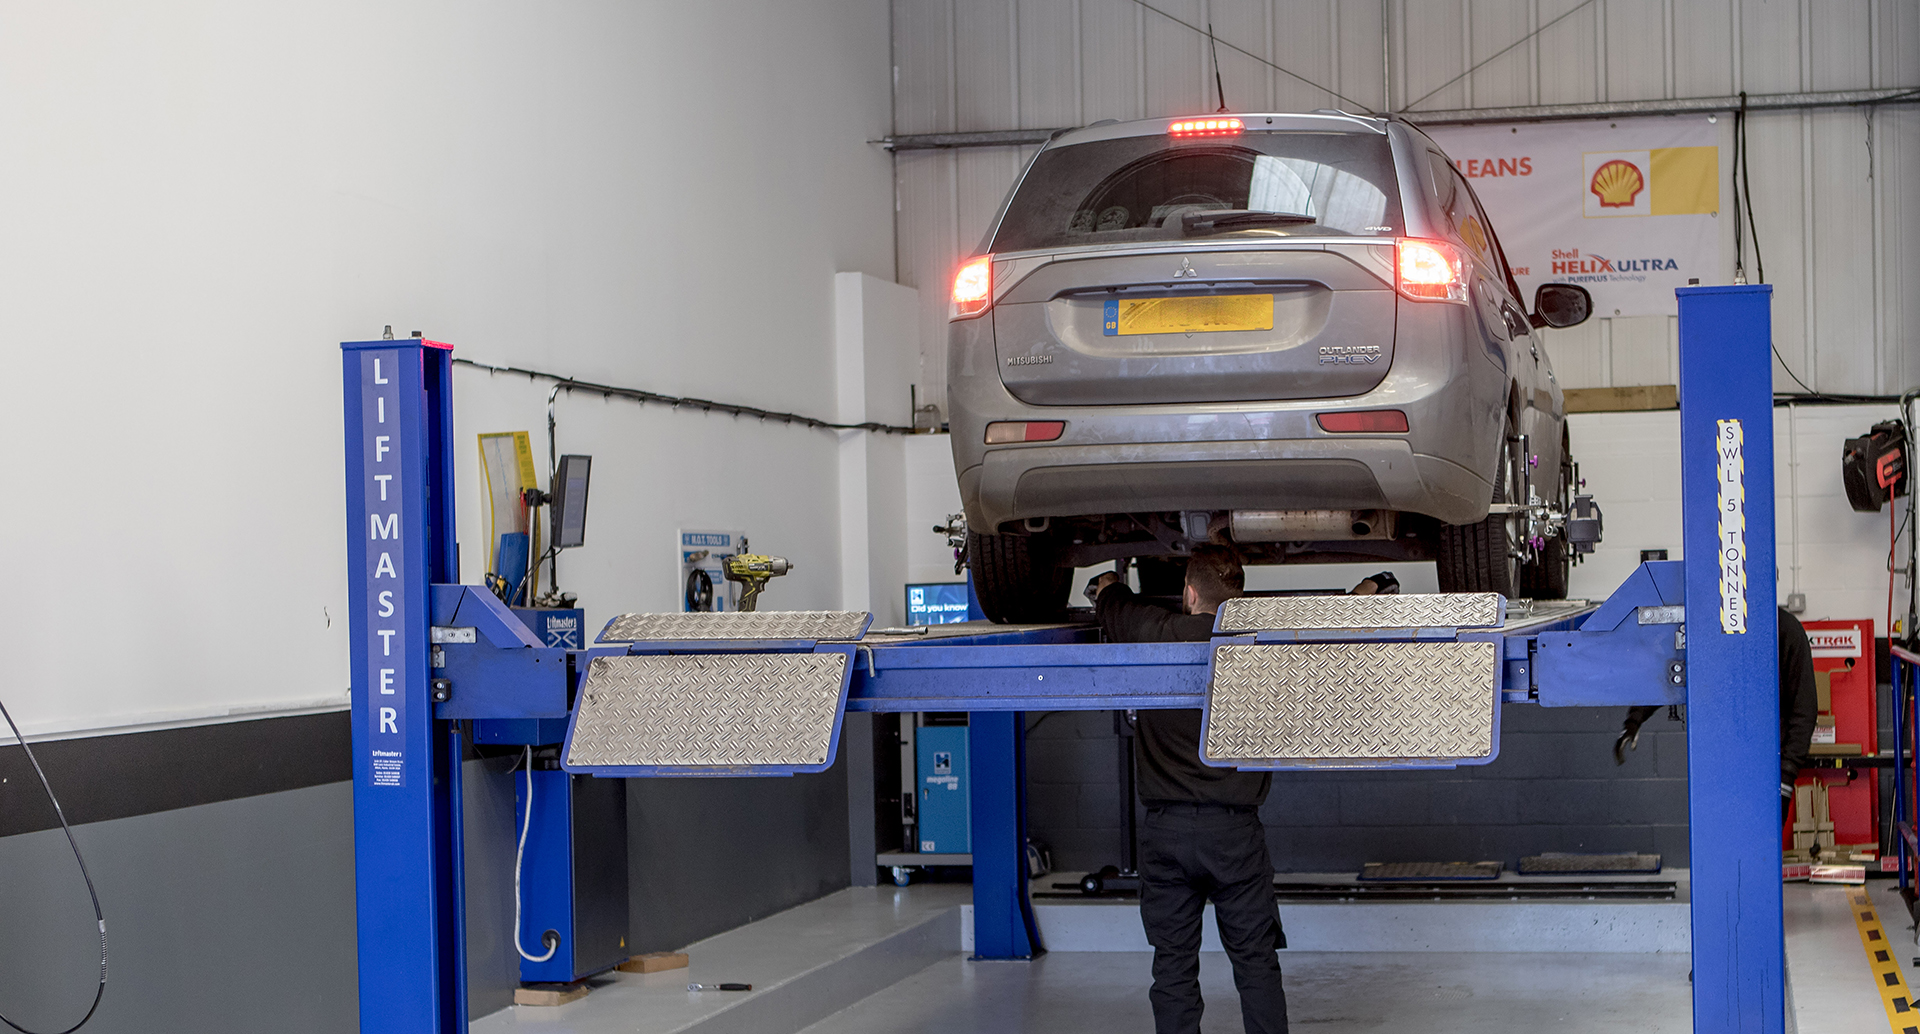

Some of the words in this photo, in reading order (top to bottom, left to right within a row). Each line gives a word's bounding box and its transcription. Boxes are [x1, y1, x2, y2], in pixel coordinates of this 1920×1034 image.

[1551, 248, 1579, 260] Shell
[1551, 259, 1615, 275] HELIX
[1617, 258, 1679, 272] ULTRA
[1568, 275, 1608, 283] PUREPLUS
[1609, 274, 1646, 282] Technology
[1105, 321, 1117, 330] GB
[1319, 345, 1380, 355] OUTLANDER
[1007, 355, 1053, 366] MITSUBISHI
[1319, 354, 1382, 365] PHEV
[1727, 498, 1736, 512] 5
[706, 535, 723, 545] TOOLS
[371, 358, 399, 735] LIFTMASTER
[1725, 531, 1740, 627] TONNES
[911, 604, 926, 613] Did
[927, 605, 943, 613] you
[944, 603, 969, 611] know
